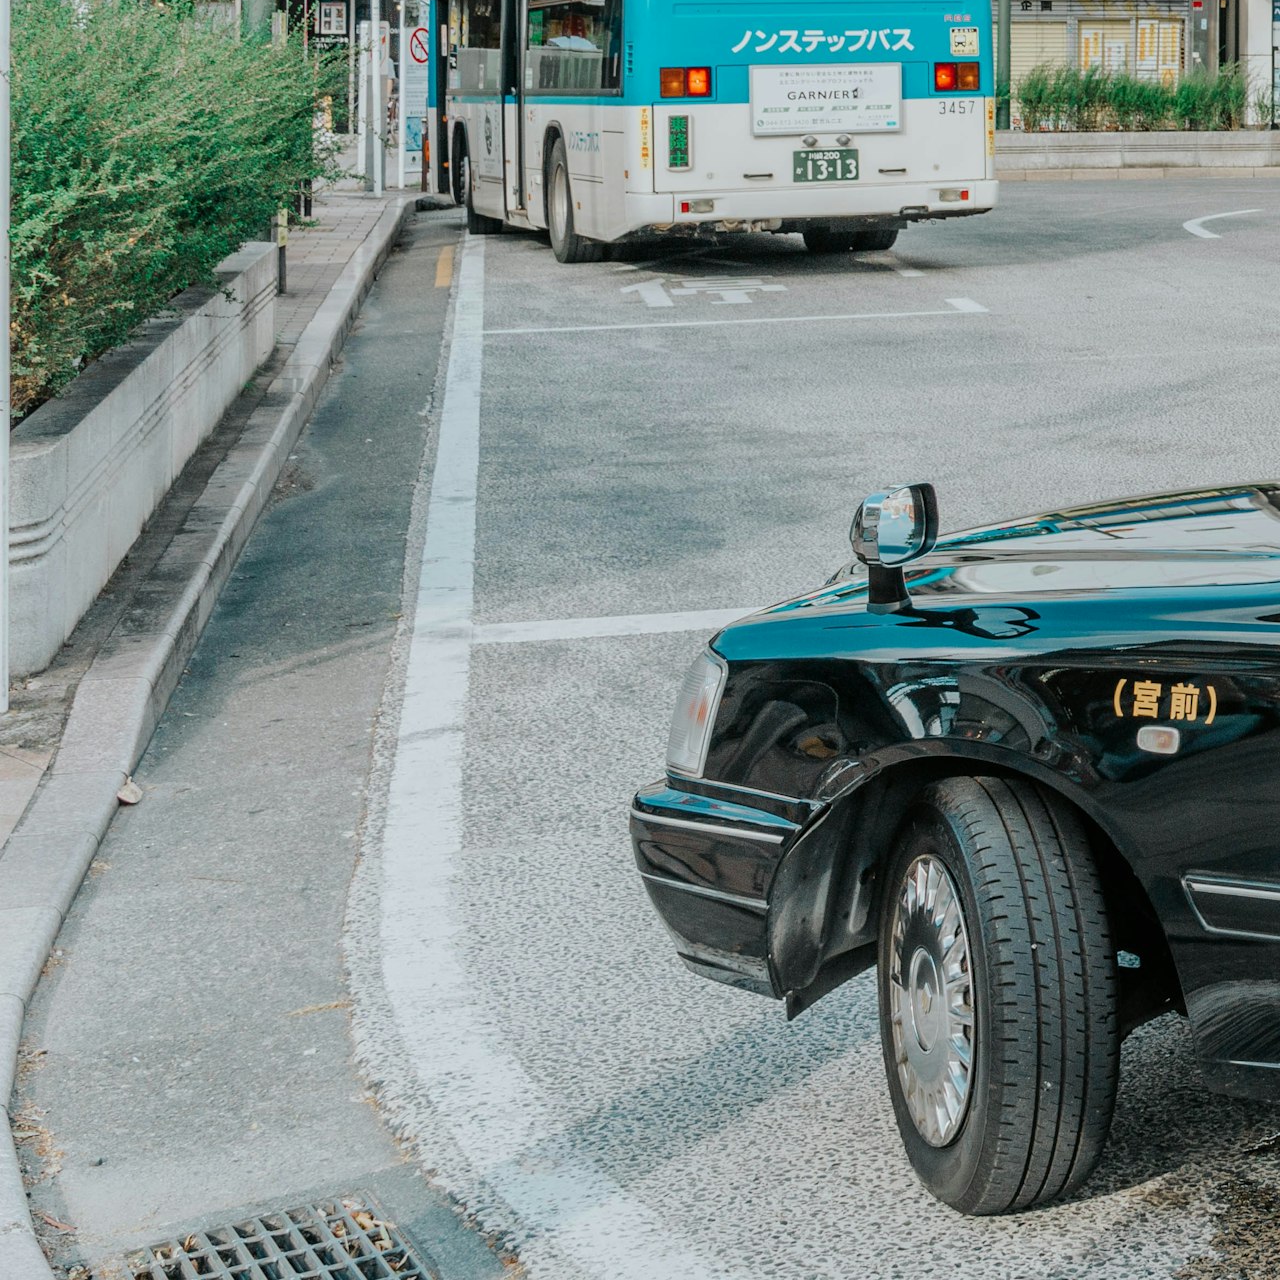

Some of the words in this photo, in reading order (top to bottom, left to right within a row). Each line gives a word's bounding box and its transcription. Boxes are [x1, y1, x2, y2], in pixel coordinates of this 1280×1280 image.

[731, 29, 914, 54] ノンステップバス
[939, 100, 976, 115] 3457
[1112, 678, 1216, 726] (宮前)
